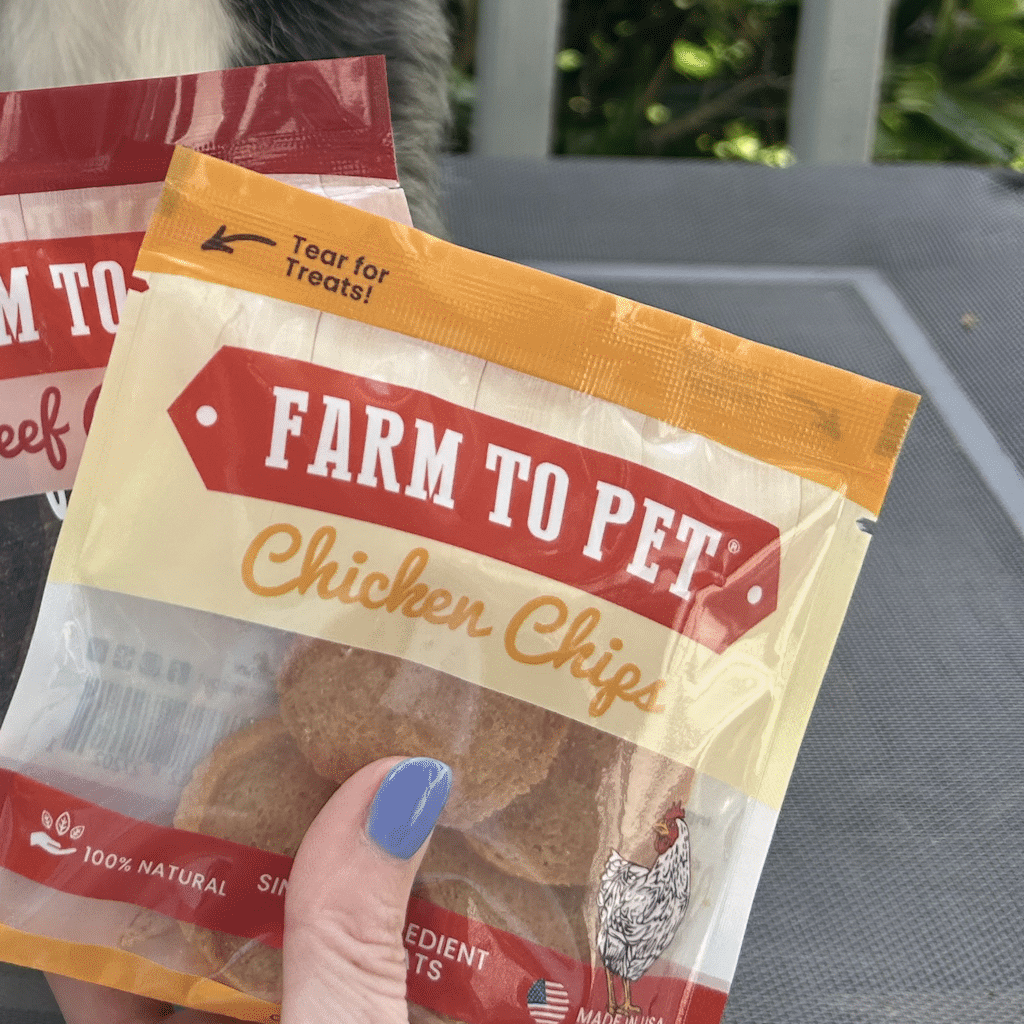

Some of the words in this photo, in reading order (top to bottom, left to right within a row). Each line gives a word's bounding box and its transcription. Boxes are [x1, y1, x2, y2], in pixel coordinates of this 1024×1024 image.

[285, 256, 373, 304] Treats!
[292, 234, 349, 269] Tear
[353, 255, 390, 284] for
[49, 259, 128, 338] TO
[264, 385, 464, 510] FARM
[485, 442, 570, 542] TO
[240, 523, 493, 640] Chicken
[503, 595, 666, 717] Chips
[83, 846, 133, 873] 100%
[137, 860, 227, 897] NATURAL
